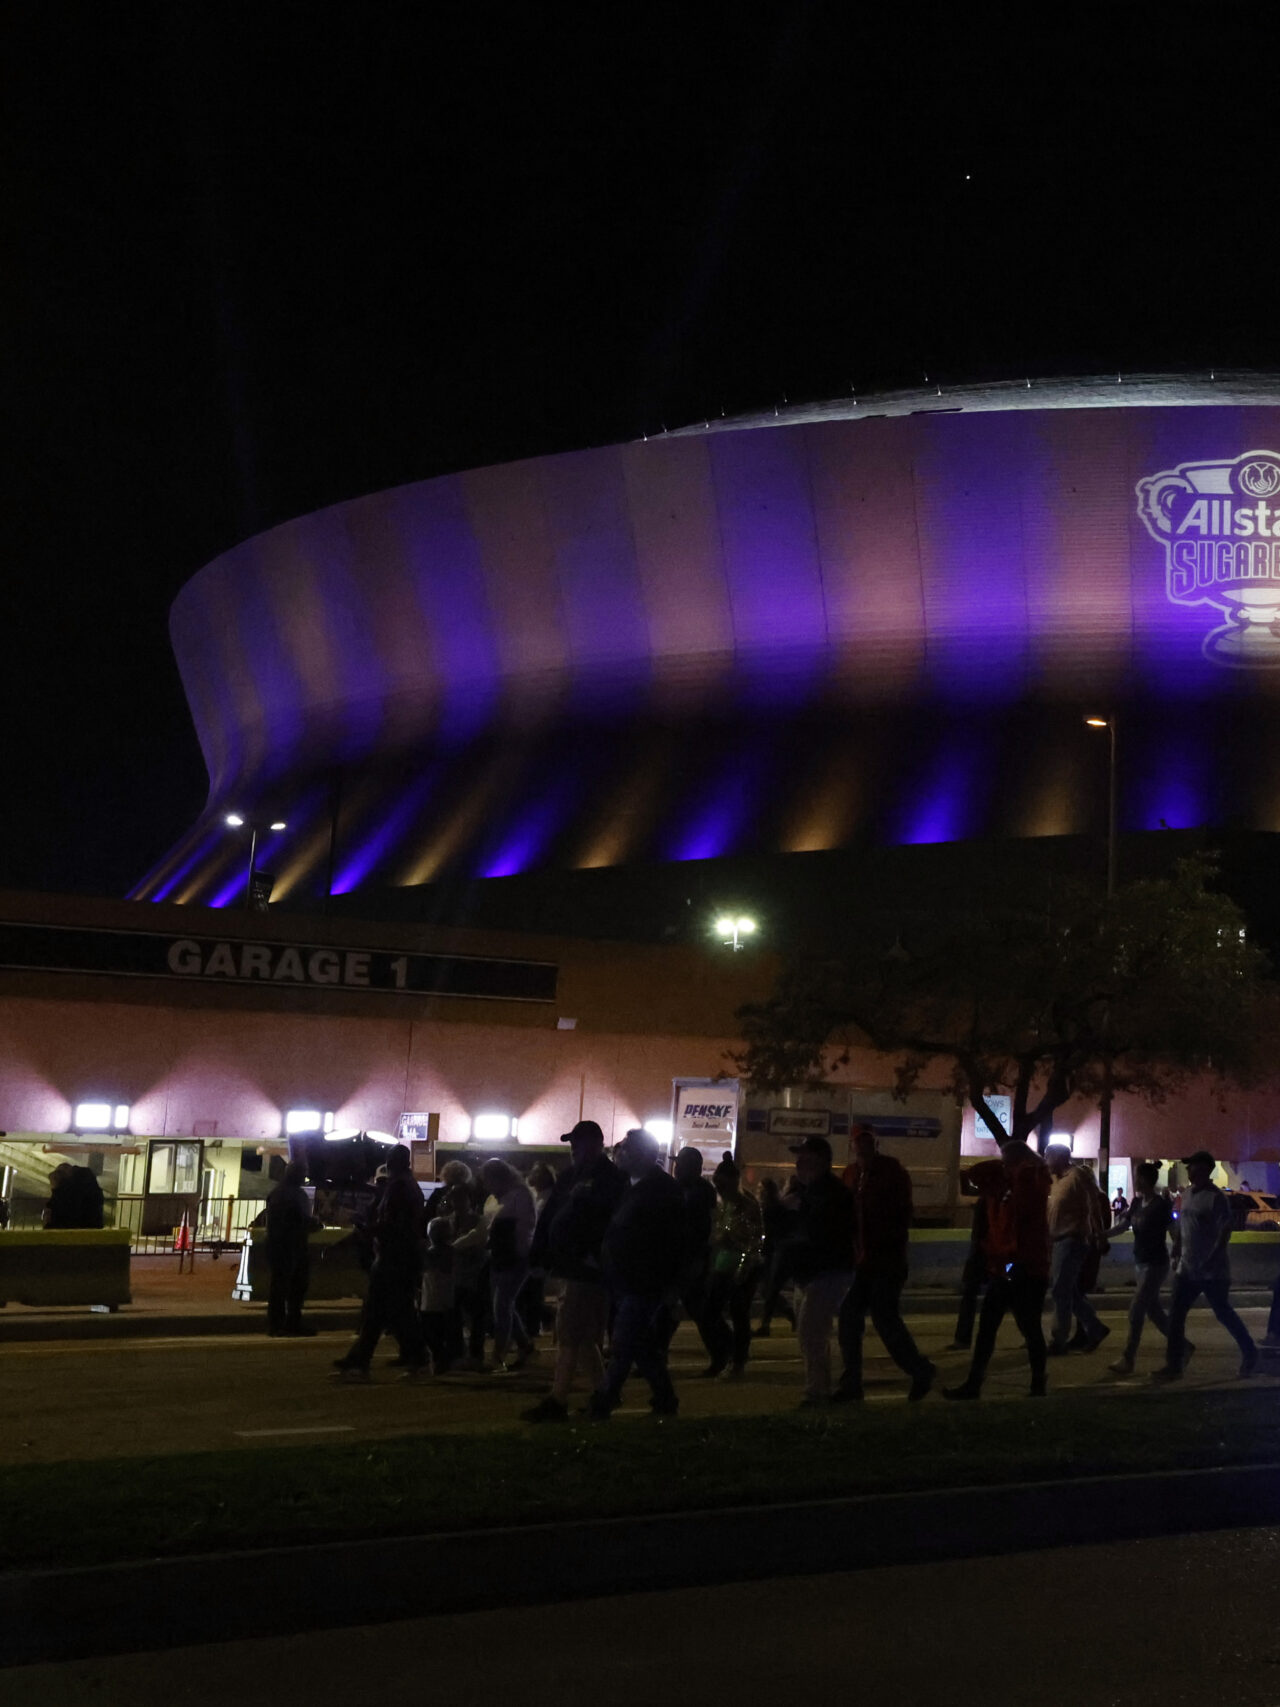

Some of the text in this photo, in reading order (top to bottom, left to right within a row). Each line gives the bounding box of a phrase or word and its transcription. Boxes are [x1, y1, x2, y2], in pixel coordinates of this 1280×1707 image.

[167, 940, 408, 987] GARAGE 1
[684, 1104, 732, 1118] PENSKE
